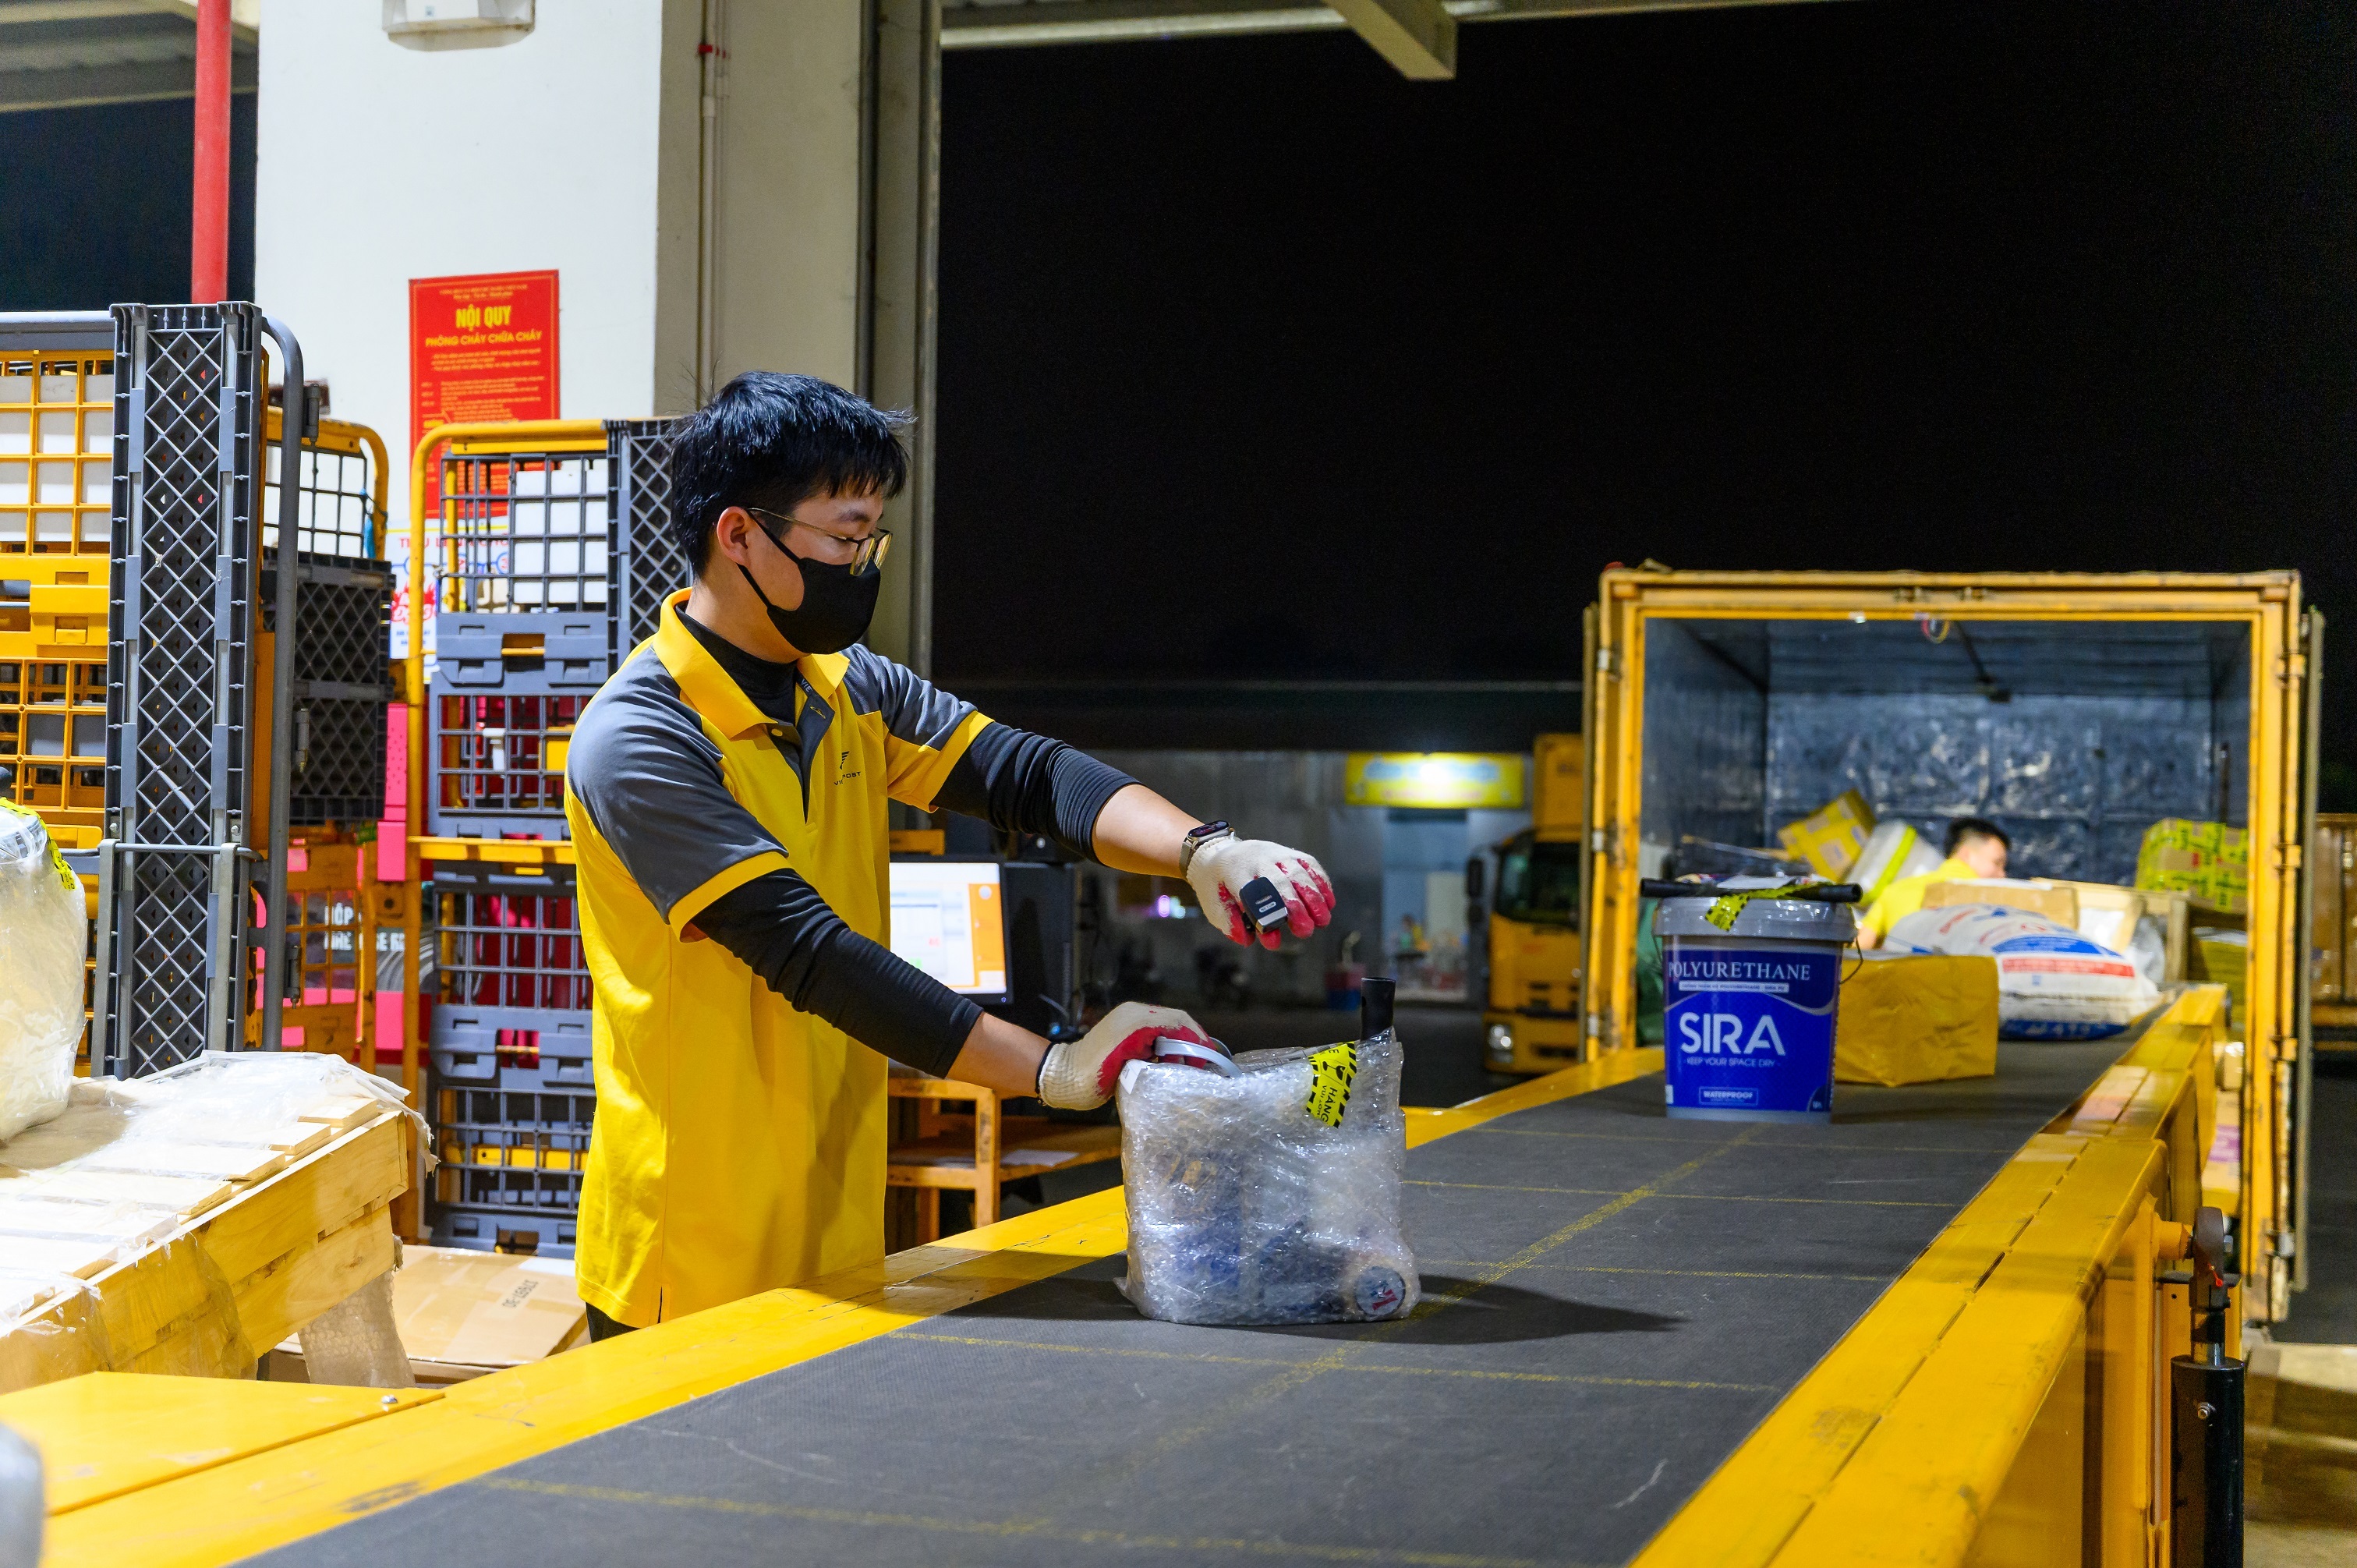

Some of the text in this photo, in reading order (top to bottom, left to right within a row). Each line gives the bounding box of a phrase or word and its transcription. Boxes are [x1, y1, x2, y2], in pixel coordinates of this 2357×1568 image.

[456, 304, 511, 331] NỘI QUY
[460, 332, 487, 345] CHÁY
[488, 331, 515, 344] CHỮA
[515, 328, 543, 342] CHÁY
[1669, 961, 1811, 981] POLYURETHANE
[1679, 1012, 1785, 1056] SIRA
[1704, 1057, 1727, 1066] YOUR
[1729, 1057, 1756, 1067] SPACE
[1758, 1058, 1775, 1067] DRY
[1703, 1091, 1753, 1099] WATERPROOF
